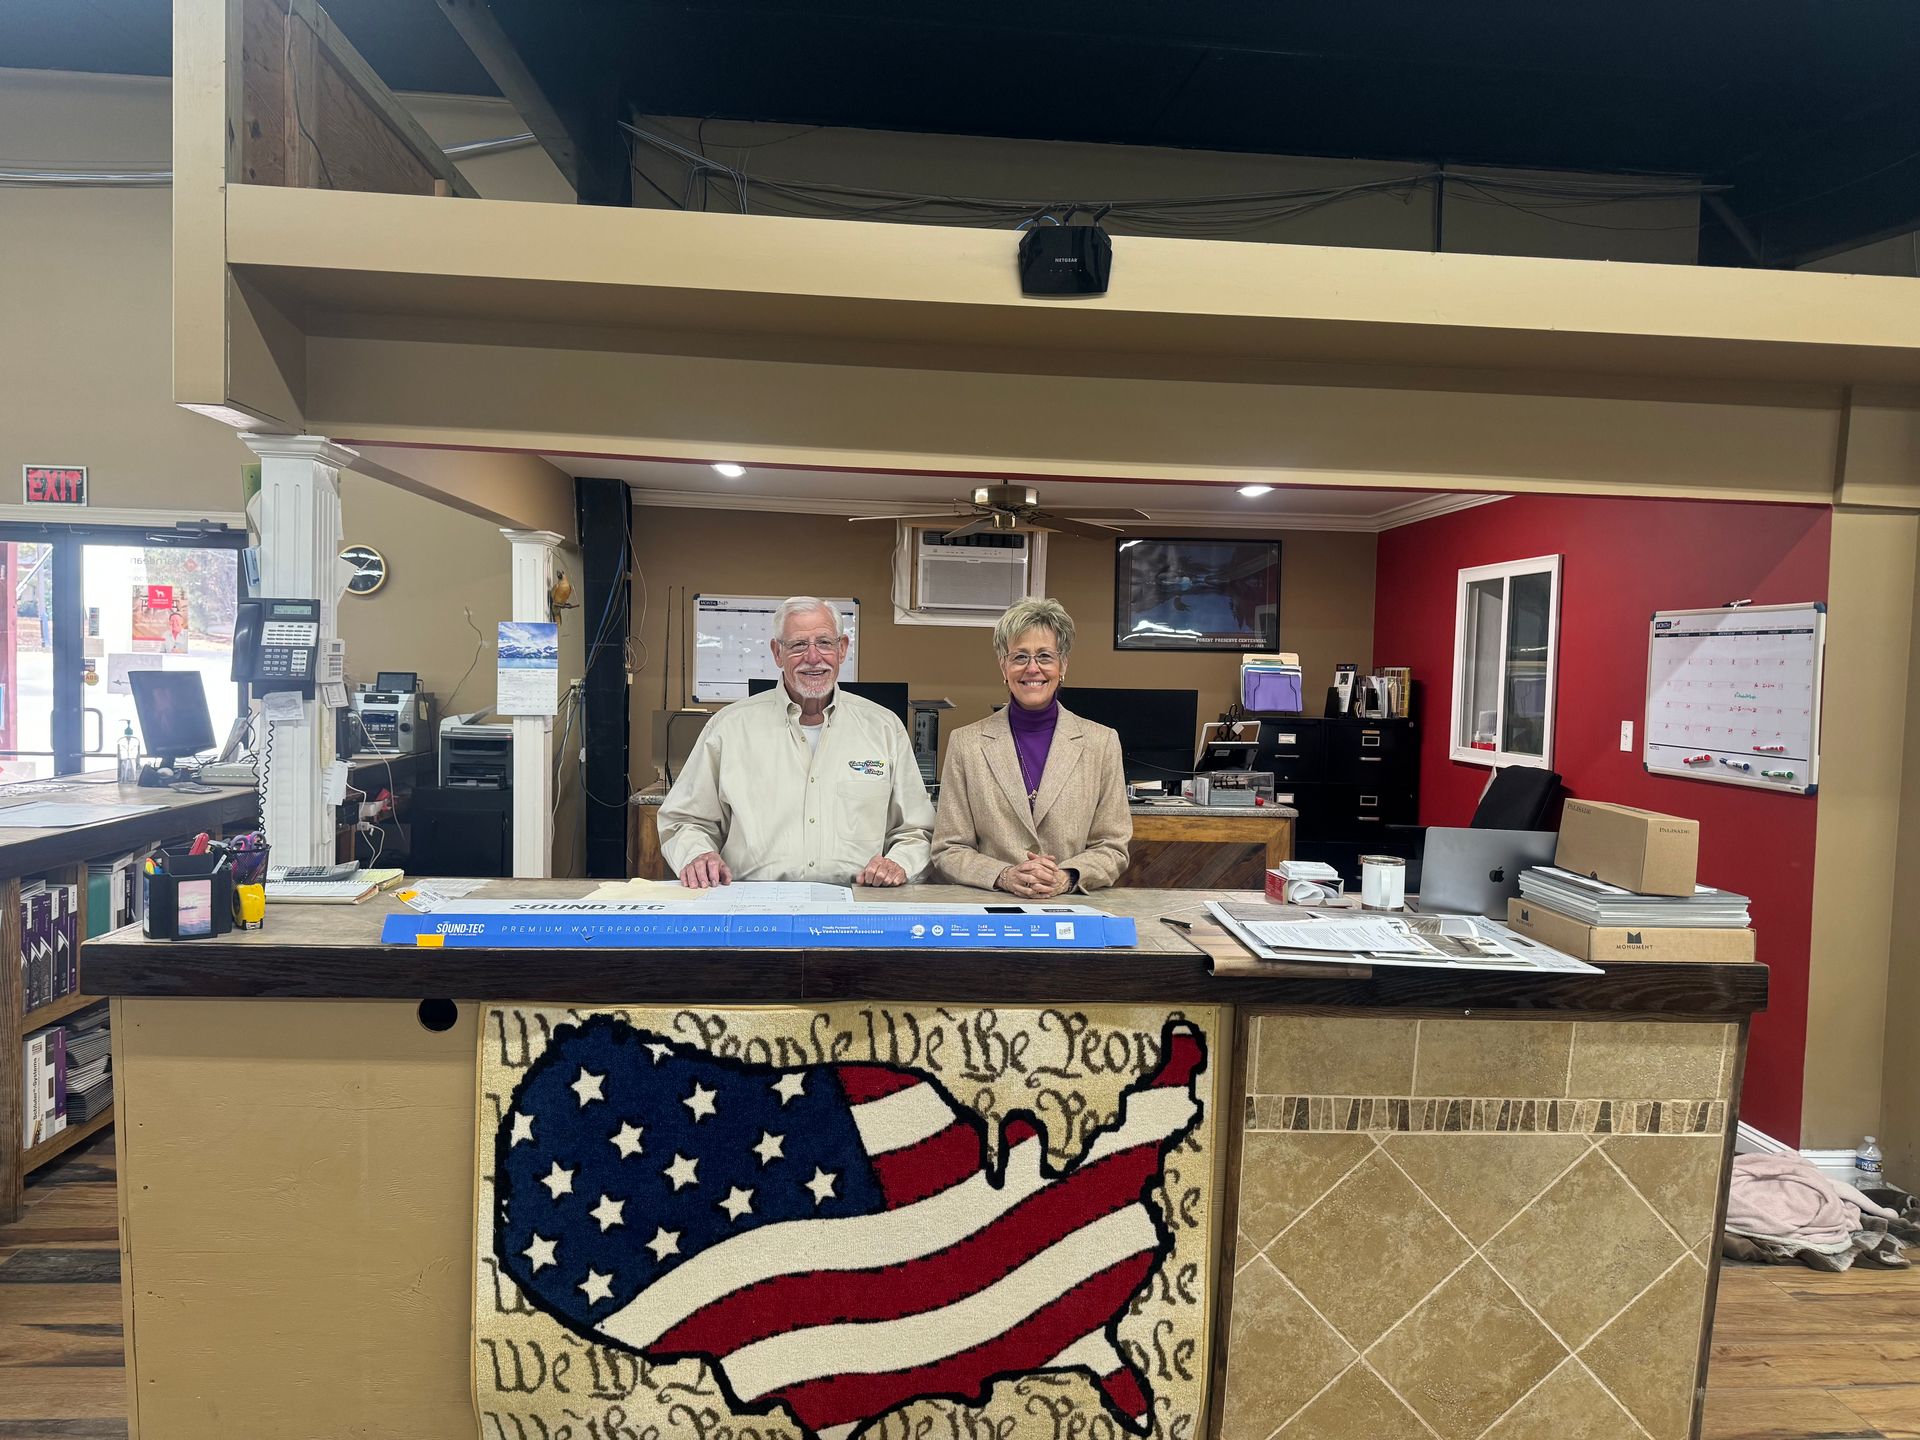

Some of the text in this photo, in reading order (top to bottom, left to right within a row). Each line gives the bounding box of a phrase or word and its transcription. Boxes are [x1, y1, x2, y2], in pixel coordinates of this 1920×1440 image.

[29, 469, 81, 501] EXIT
[436, 923, 485, 933] SOUND-TEC
[666, 925, 729, 933] FLOATING
[859, 1009, 943, 1070] We
